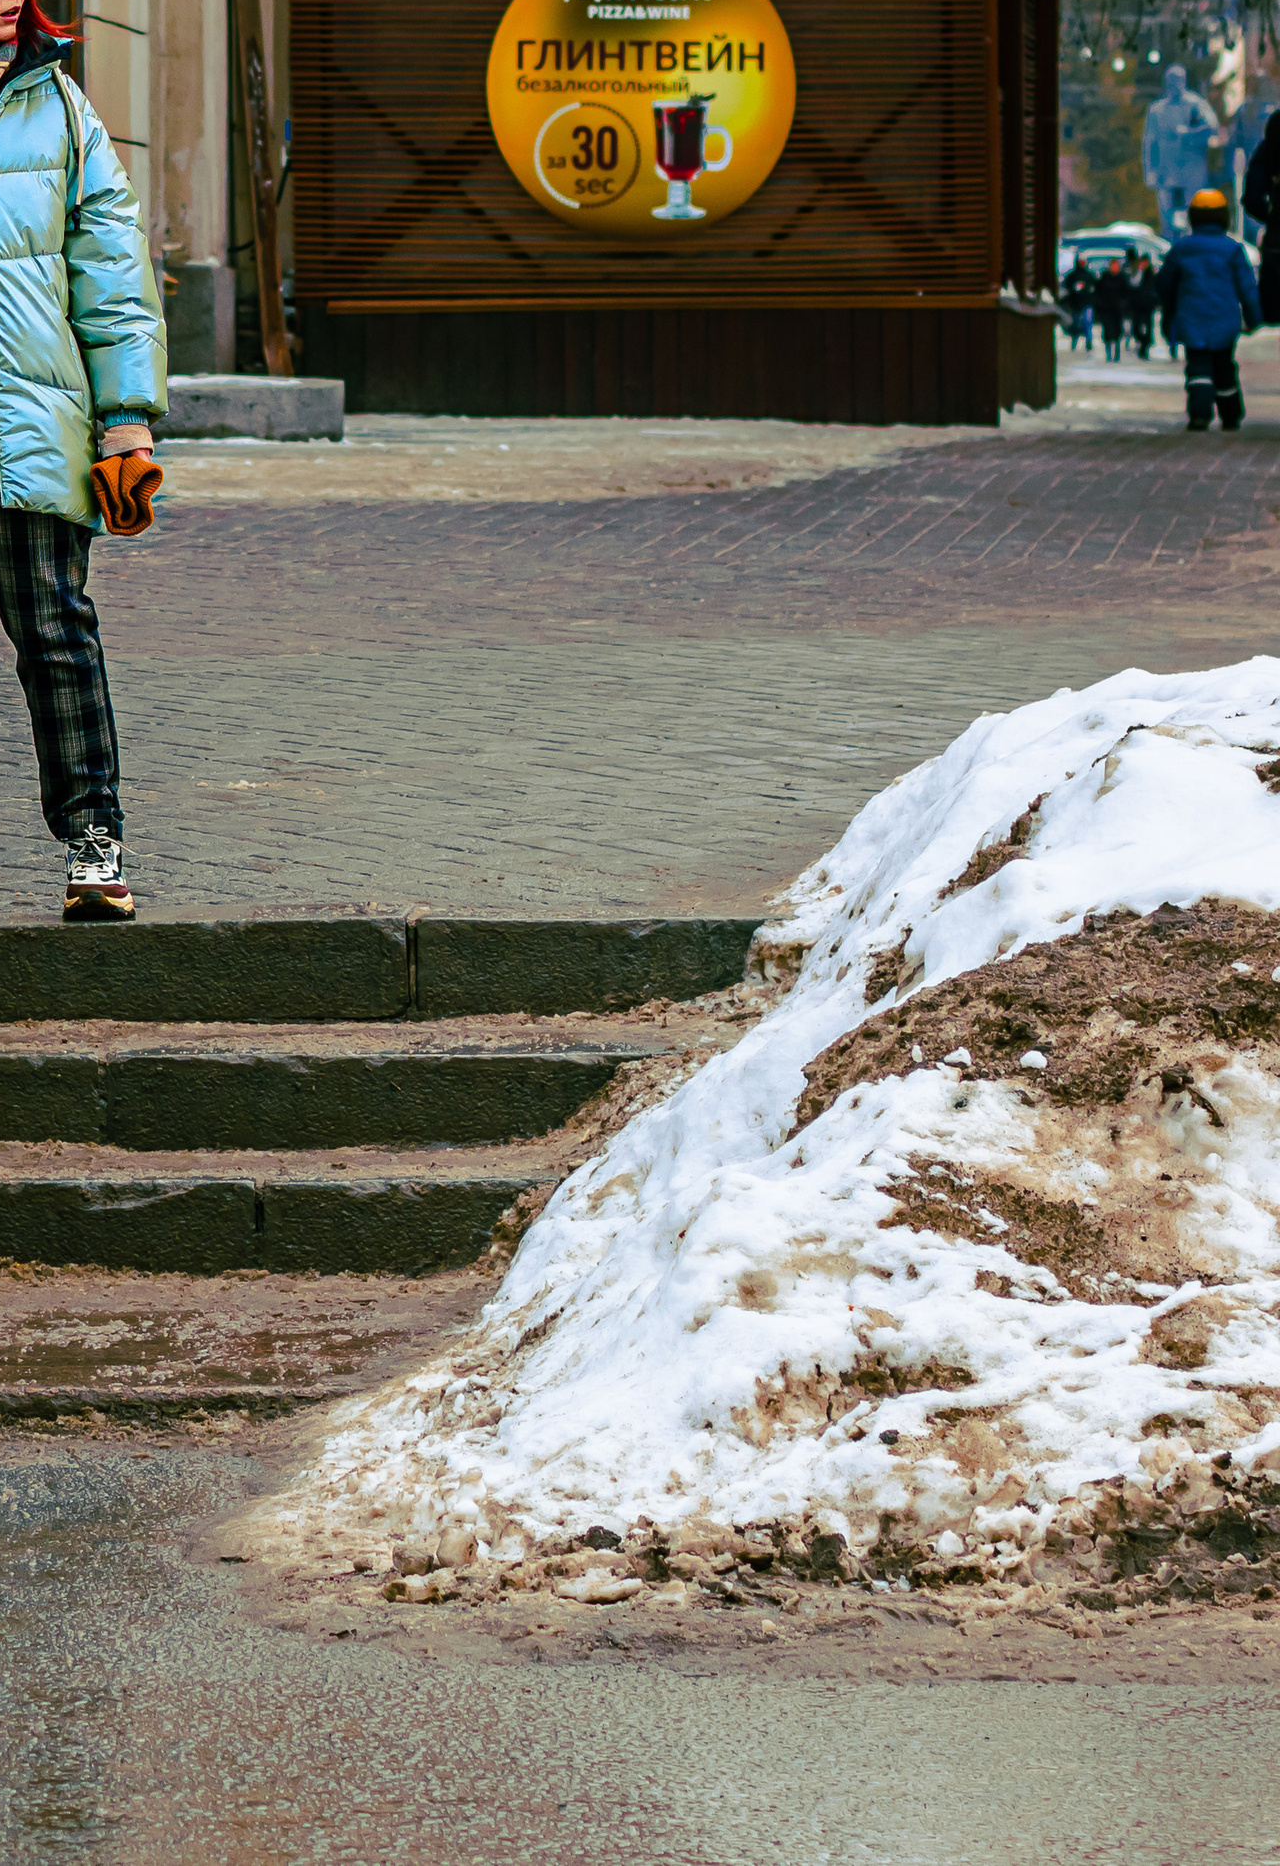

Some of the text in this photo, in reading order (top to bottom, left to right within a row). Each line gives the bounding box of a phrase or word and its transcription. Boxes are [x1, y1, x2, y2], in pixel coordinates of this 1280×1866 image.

[588, 5, 691, 20] PIZZA&WINE
[517, 33, 765, 72] ГЛИНТВЕЙН
[517, 75, 690, 94] безалкогольный
[547, 125, 619, 171] за 30
